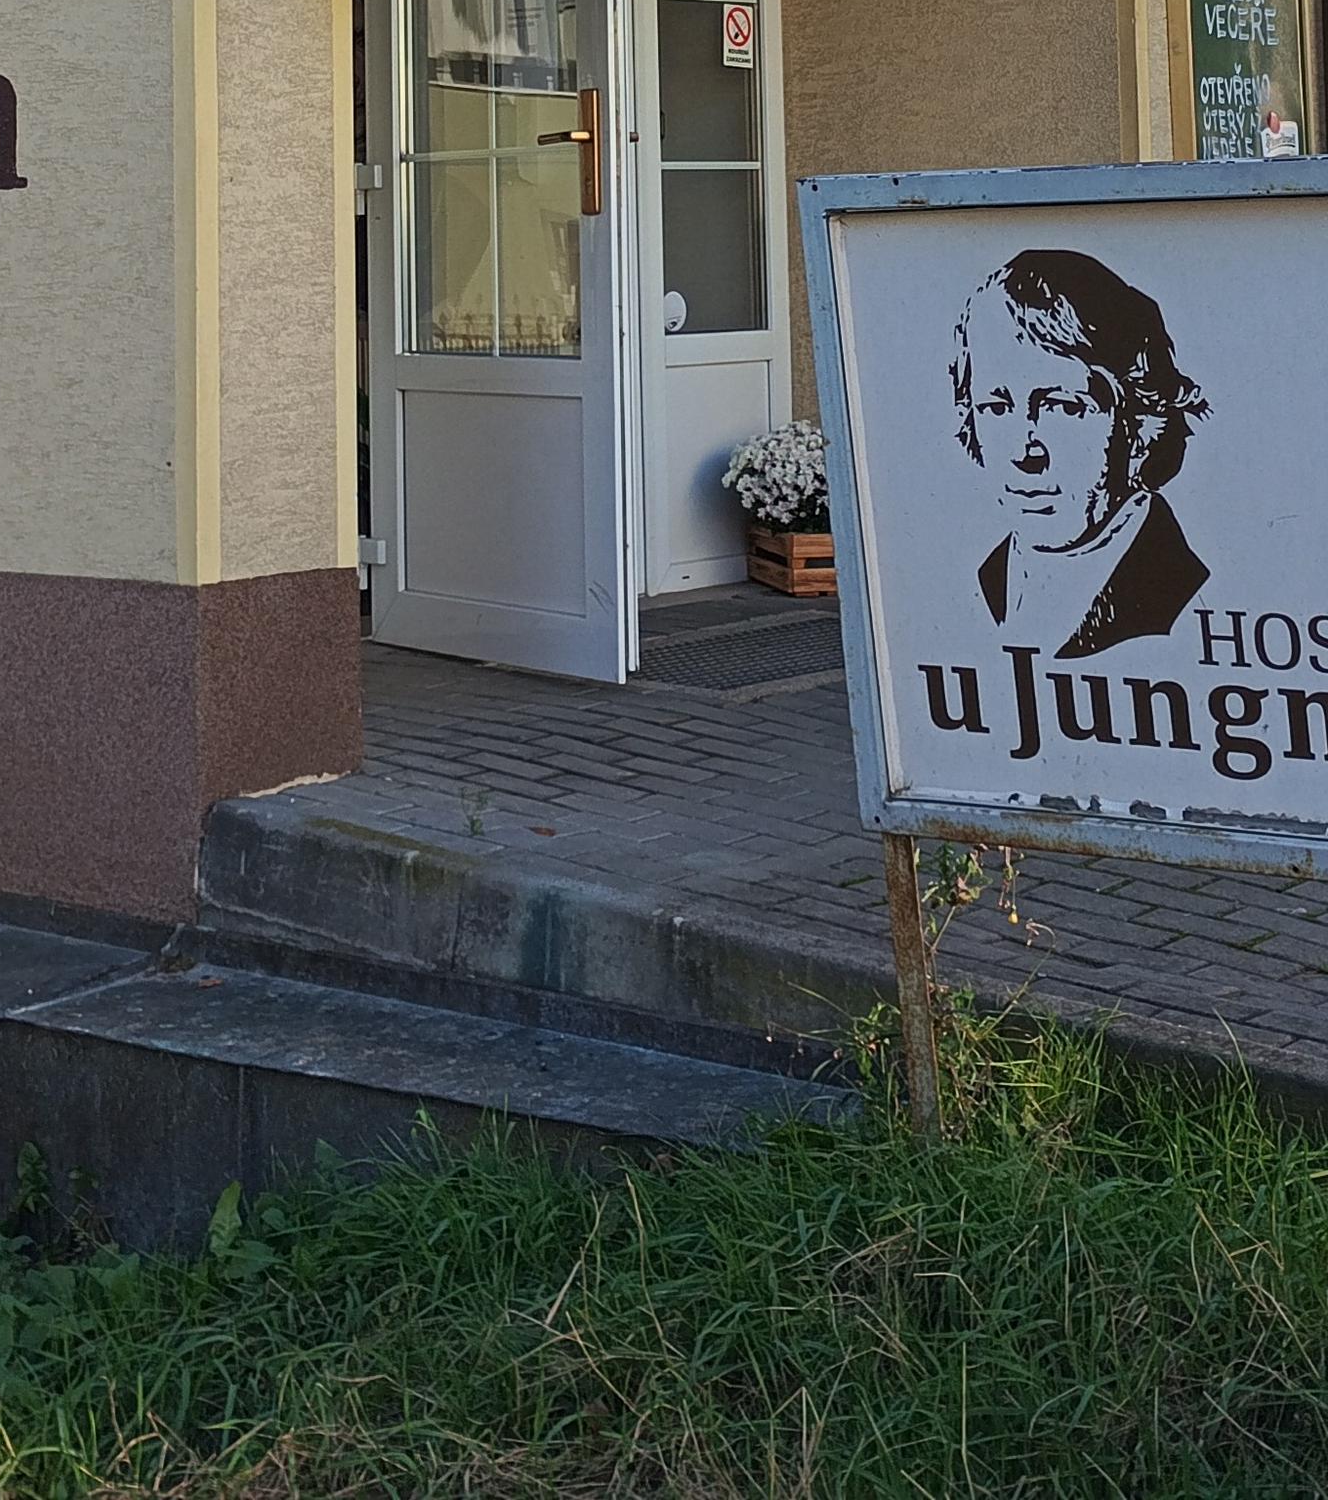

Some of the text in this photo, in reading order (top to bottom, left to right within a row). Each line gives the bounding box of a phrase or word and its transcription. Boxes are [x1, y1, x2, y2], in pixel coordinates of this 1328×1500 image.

[1200, 62, 1270, 108] OTEVŘENO
[1203, 105, 1245, 138] ÚTERÝ
[917, 661, 991, 735] u
